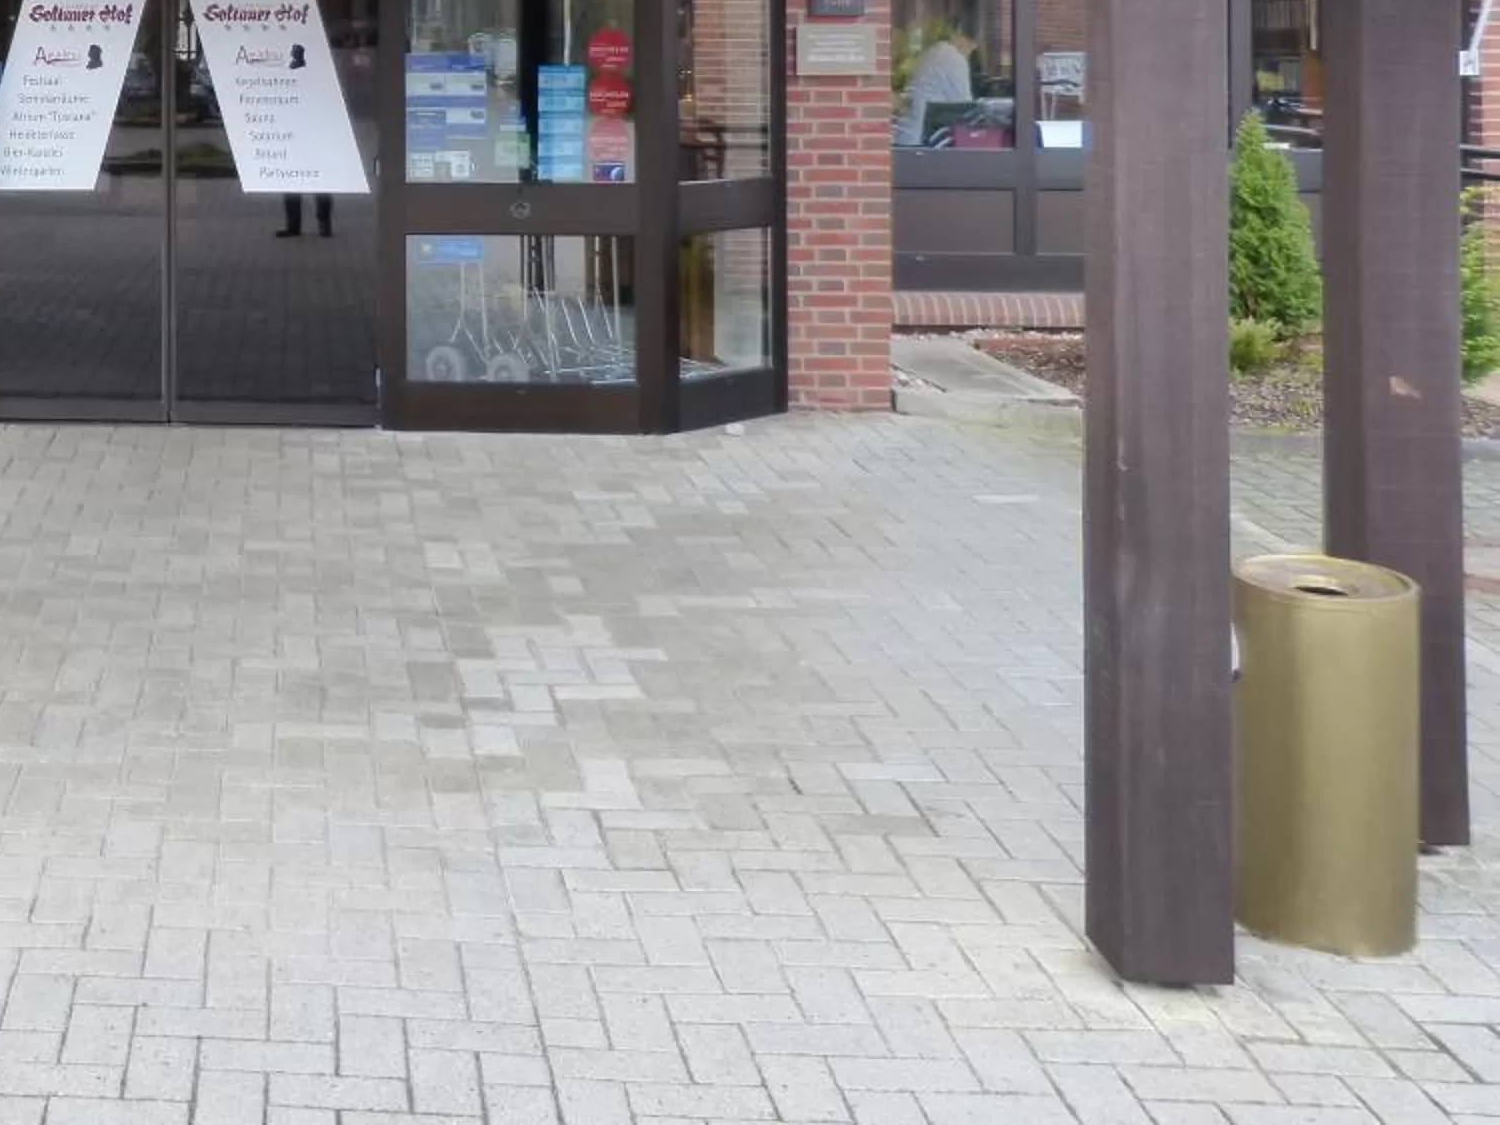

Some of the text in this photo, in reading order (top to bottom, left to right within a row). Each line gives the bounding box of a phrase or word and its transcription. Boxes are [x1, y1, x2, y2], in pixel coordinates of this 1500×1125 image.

[28, 3, 133, 24] Soltauer Hof
[203, 3, 309, 25] Soltauer Hof
